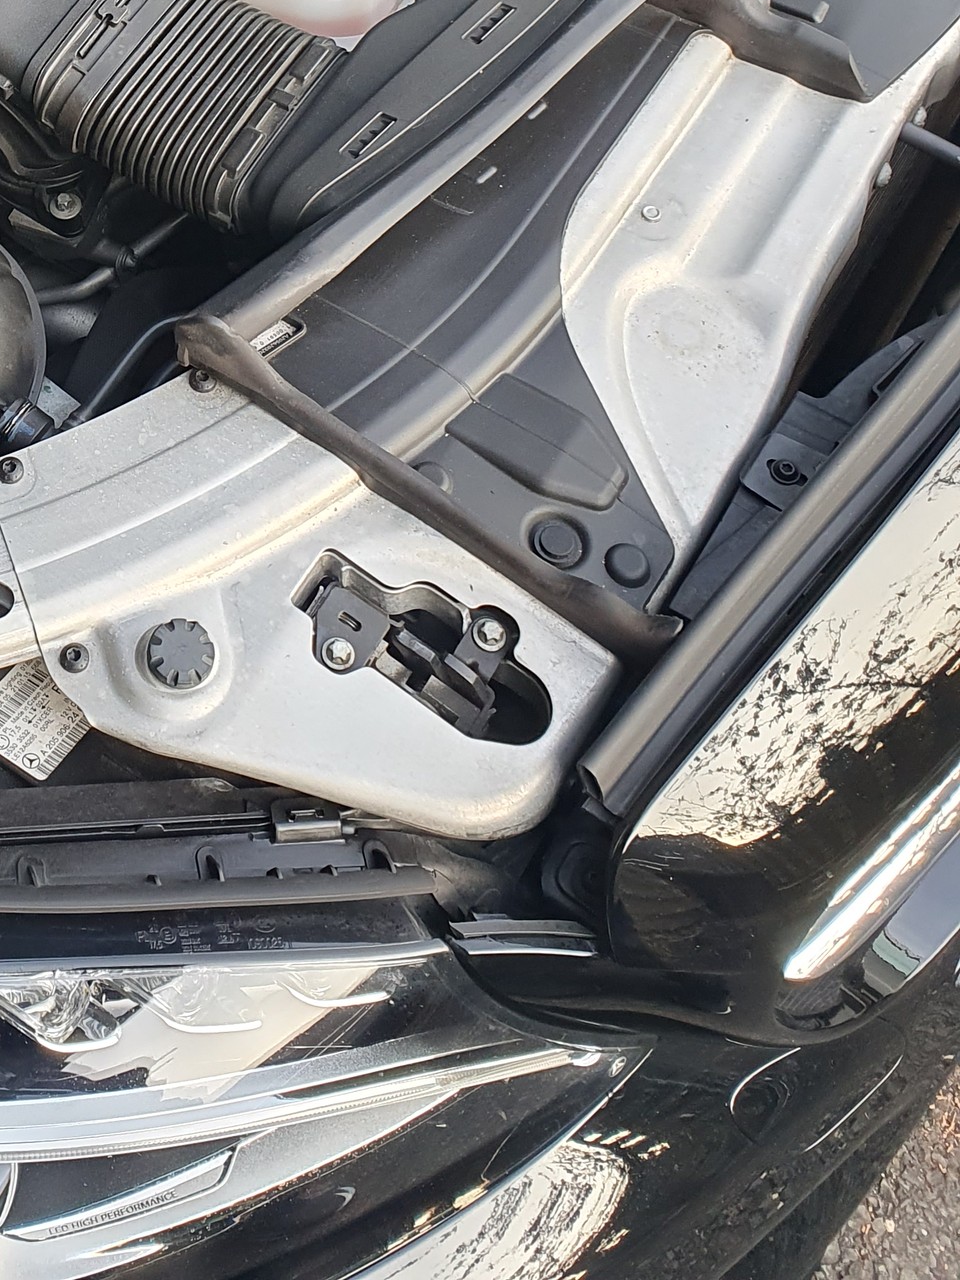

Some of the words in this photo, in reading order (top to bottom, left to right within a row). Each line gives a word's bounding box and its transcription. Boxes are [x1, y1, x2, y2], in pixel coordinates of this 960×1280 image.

[1, 672, 23, 691] Lighting
[11, 710, 25, 724] Made
[26, 692, 41, 707] Czech
[45, 736, 60, 750] 205
[67, 712, 79, 723] 24
[48, 1224, 70, 1236] LED
[71, 1215, 100, 1229] HIGH
[100, 1189, 179, 1221] PERFORMANCE
